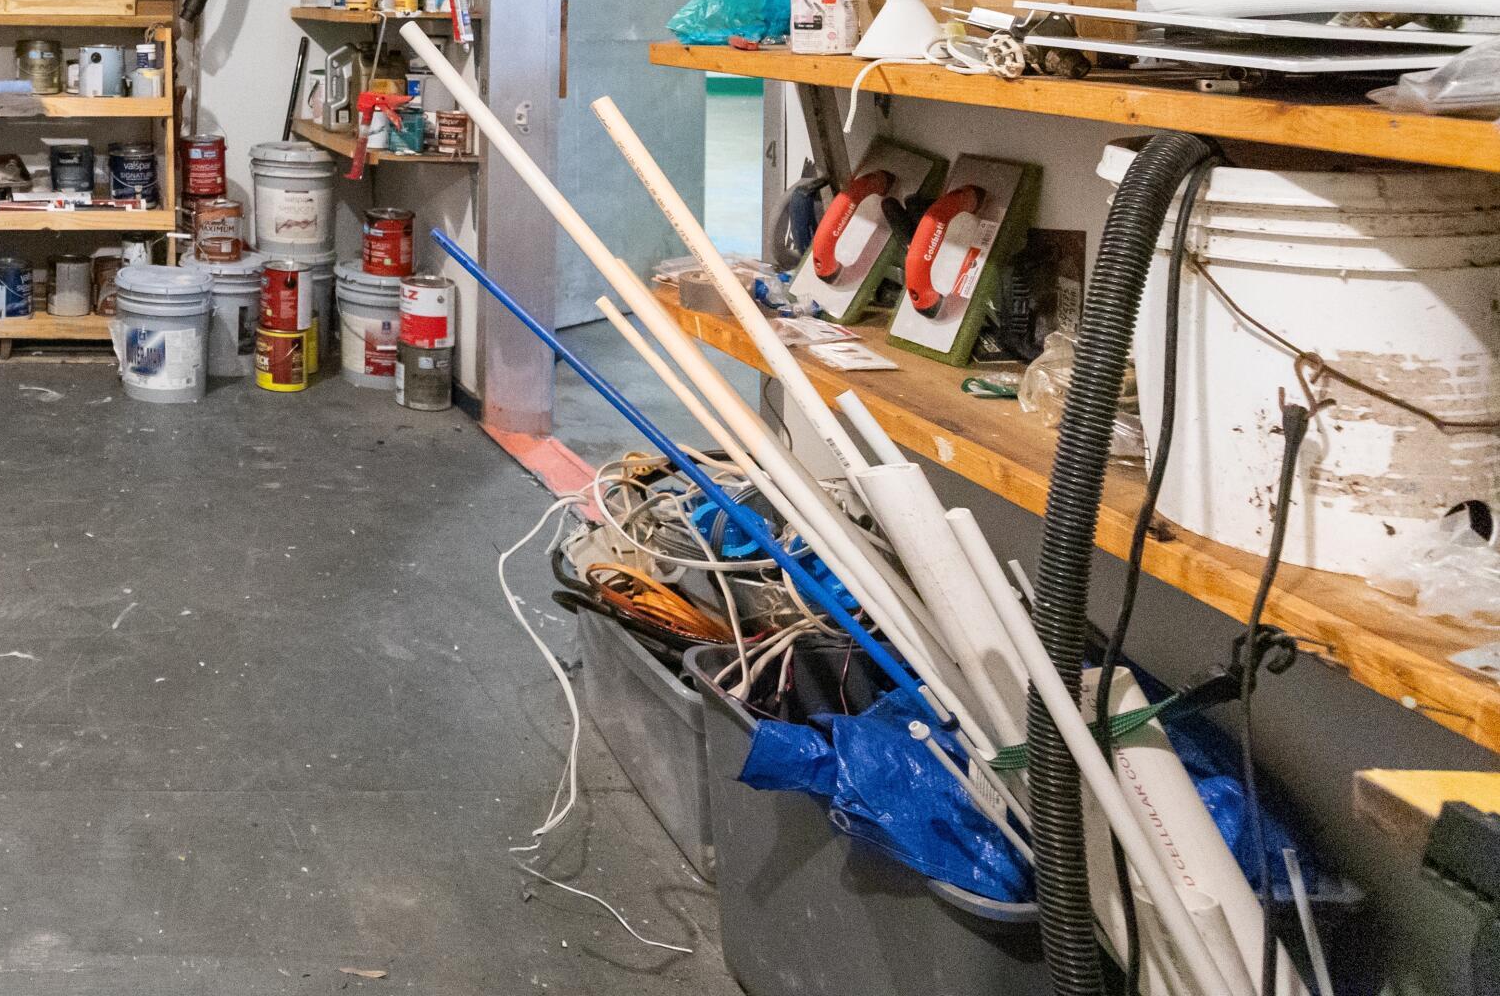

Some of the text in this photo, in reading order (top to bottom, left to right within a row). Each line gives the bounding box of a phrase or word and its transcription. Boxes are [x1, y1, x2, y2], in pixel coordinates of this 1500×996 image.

[123, 161, 151, 171] valspar
[766, 140, 777, 167] 4
[833, 203, 855, 237] Goldblatt
[924, 222, 945, 262] Goldblatt
[1134, 784, 1187, 871] CELLULAR
